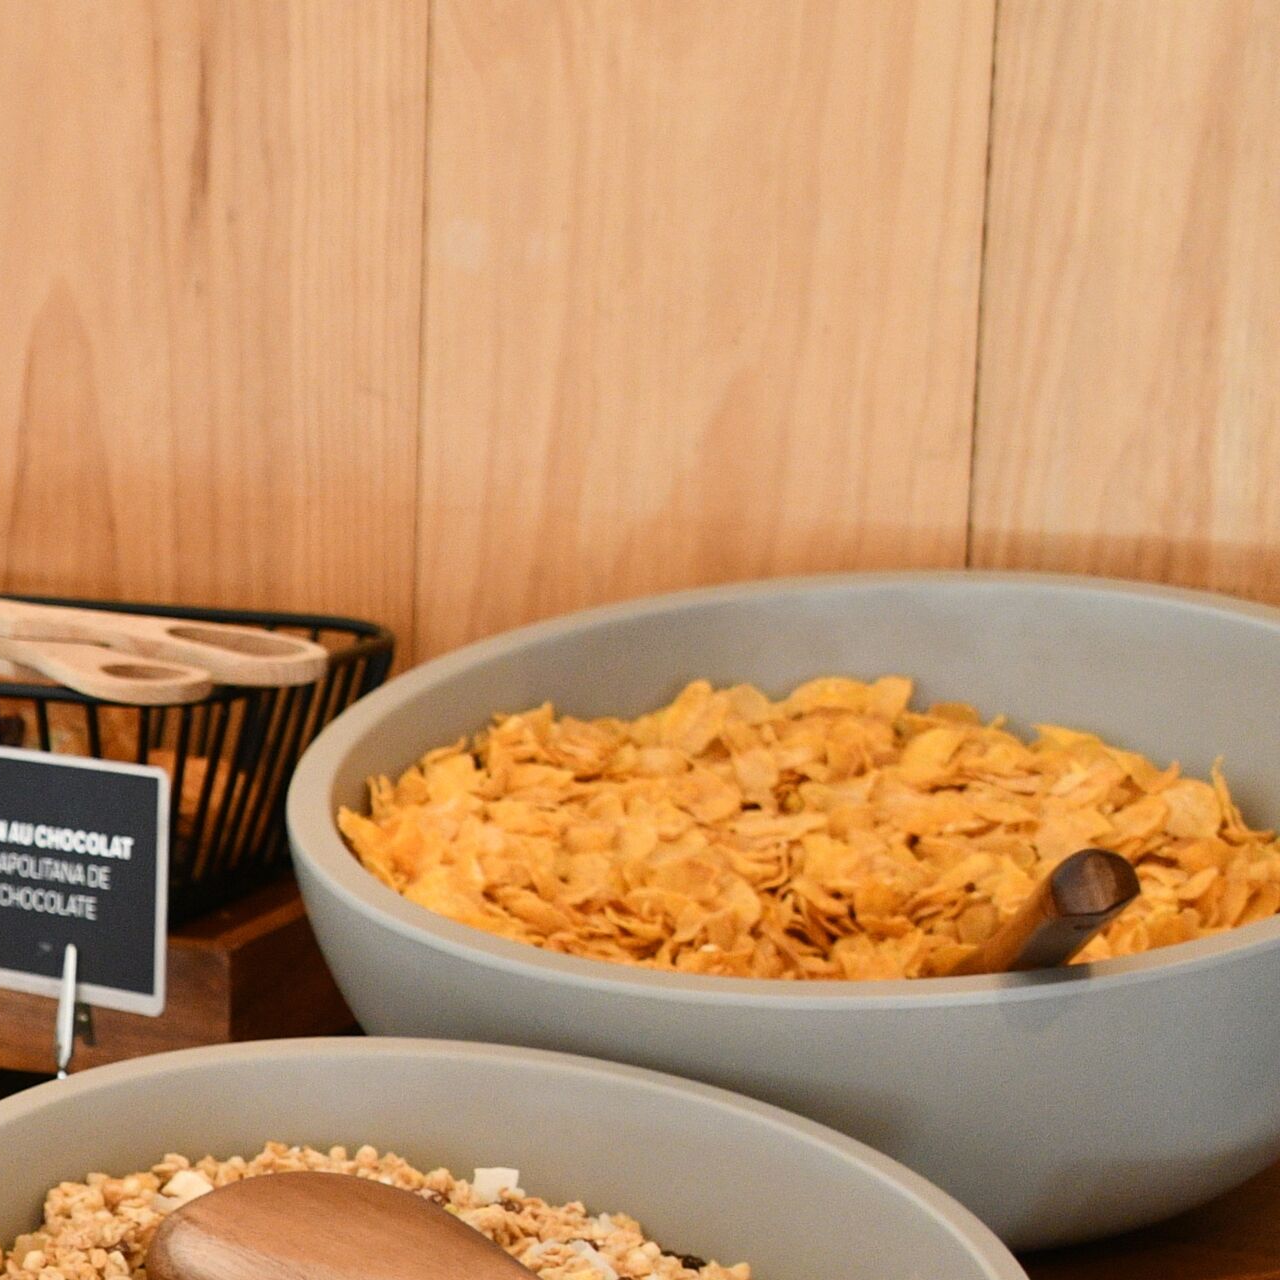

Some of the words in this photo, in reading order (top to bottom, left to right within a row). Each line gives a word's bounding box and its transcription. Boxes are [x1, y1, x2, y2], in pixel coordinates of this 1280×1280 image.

[8, 821, 34, 847] AU
[34, 824, 135, 860] CHOCOLAT
[87, 865, 112, 890] DE
